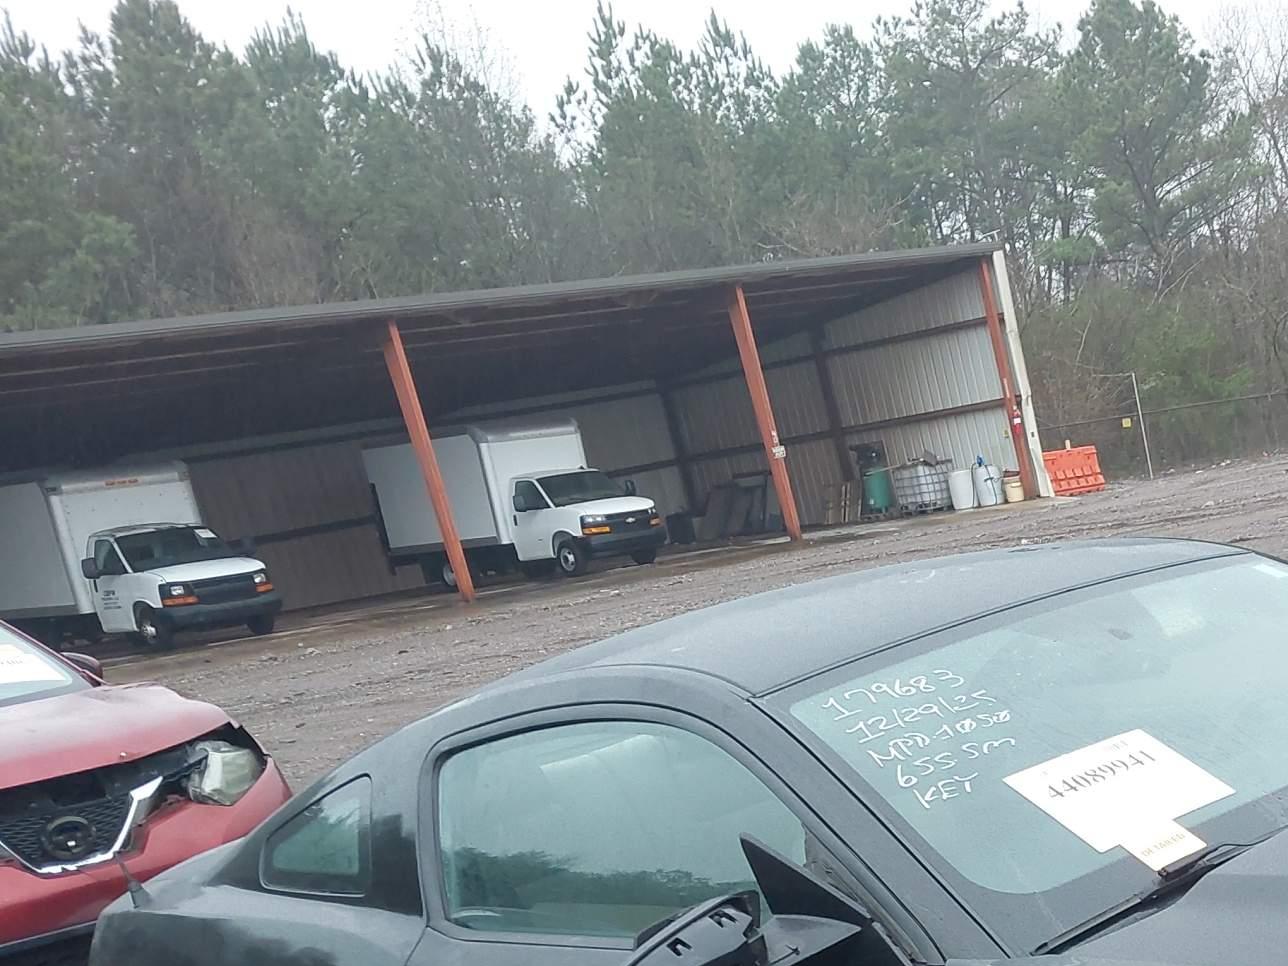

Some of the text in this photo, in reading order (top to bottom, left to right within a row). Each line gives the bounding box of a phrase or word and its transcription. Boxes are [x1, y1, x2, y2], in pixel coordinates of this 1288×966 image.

[821, 669, 965, 721] 179683
[912, 771, 979, 809] KEY
[1047, 750, 1156, 798] 44089941
